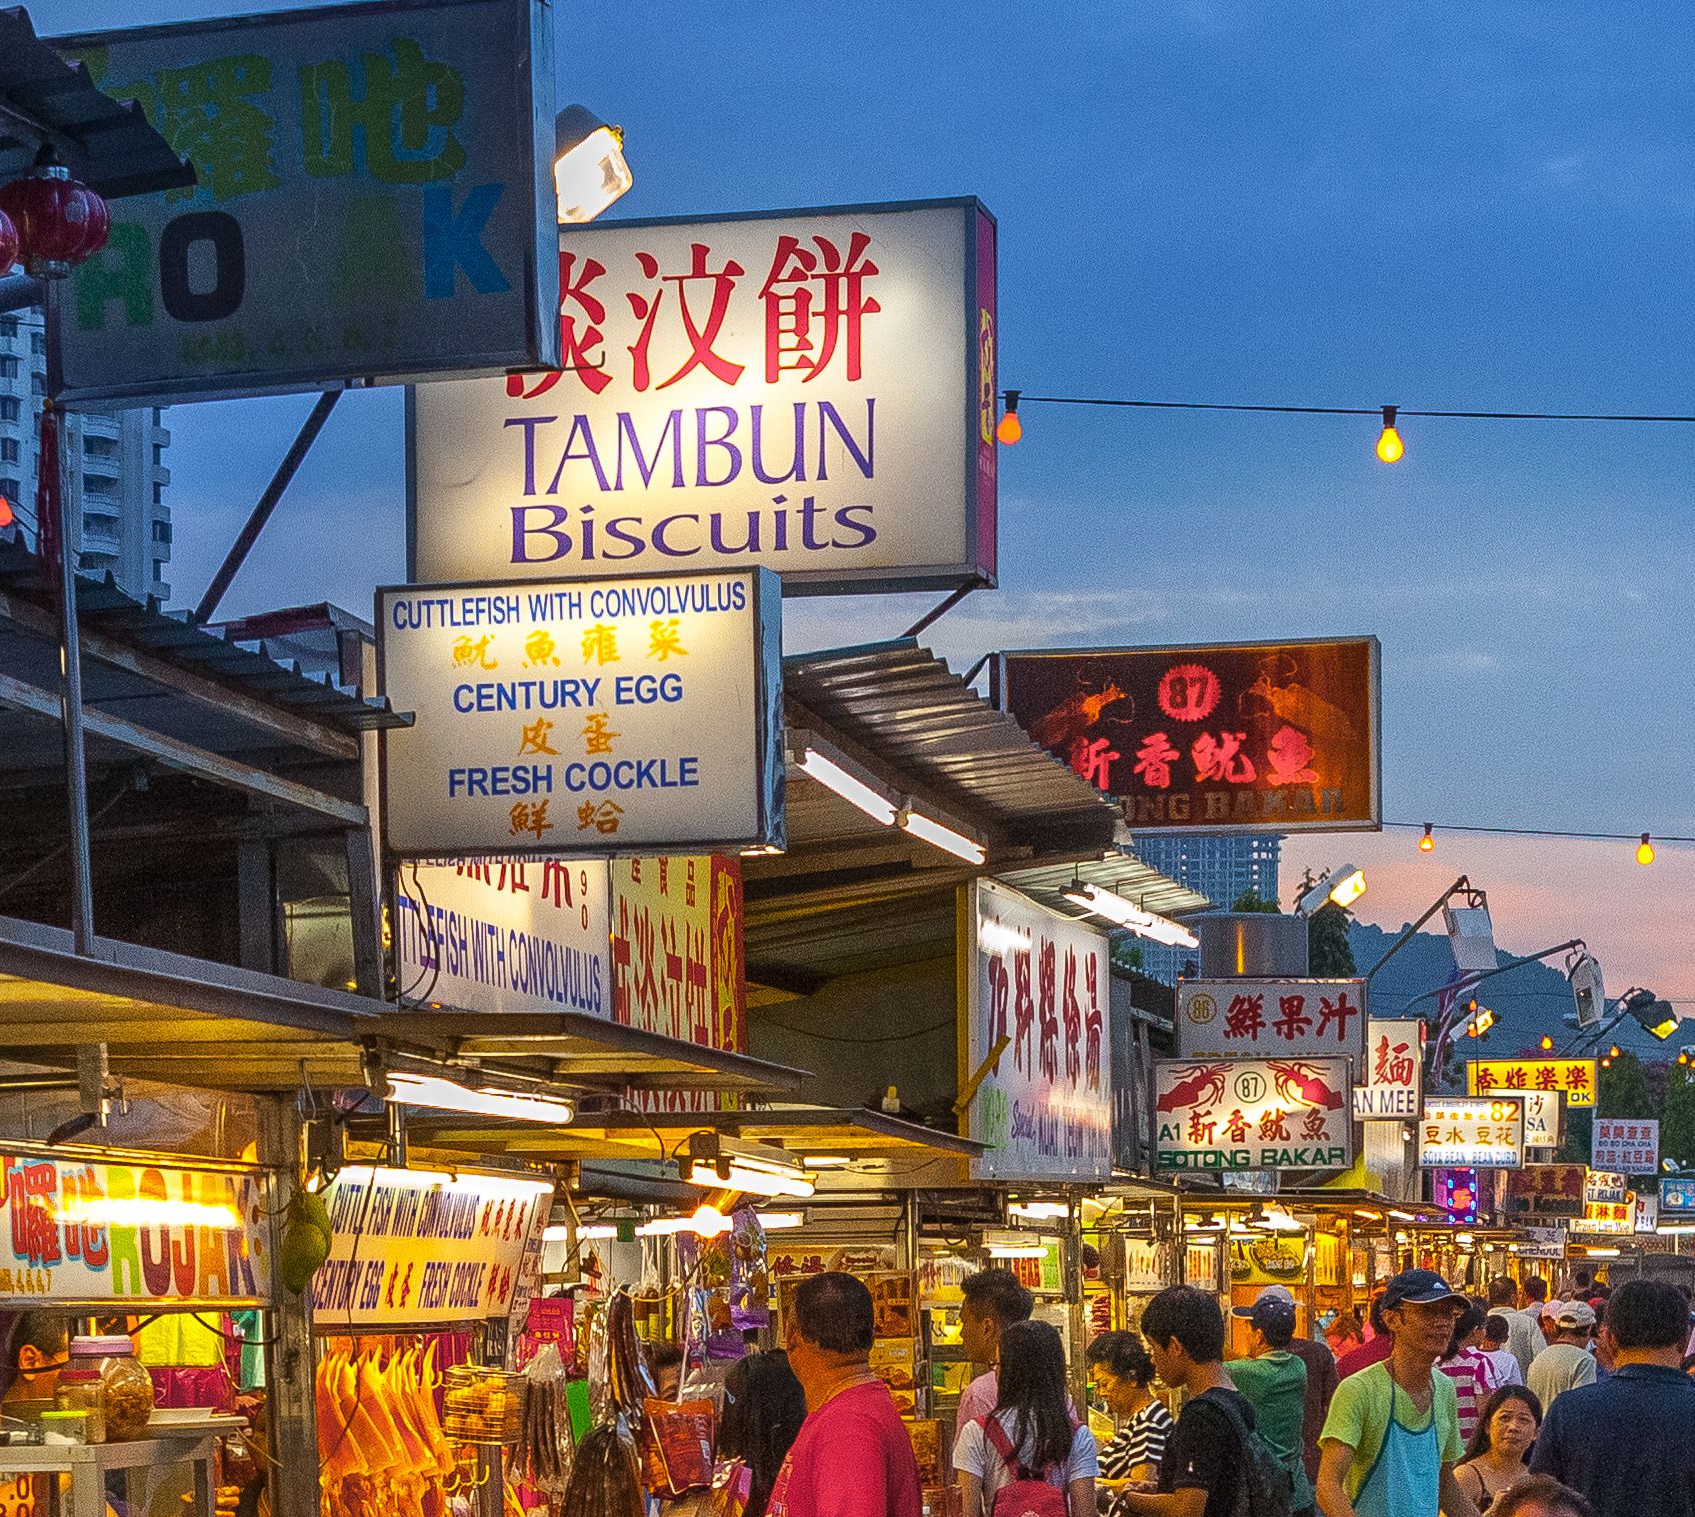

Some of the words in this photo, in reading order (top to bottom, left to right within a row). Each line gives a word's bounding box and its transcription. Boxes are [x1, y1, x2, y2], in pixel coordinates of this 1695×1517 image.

[504, 397, 877, 497] TAMBUN
[509, 494, 879, 566] Biscuits
[392, 594, 520, 631] CUTTLEFISH
[528, 588, 583, 623] WITH
[589, 581, 746, 619] CONVOLVULUS
[453, 677, 602, 714] CENTURY
[614, 673, 684, 705] EGG
[518, 712, 622, 757] 皮蛋
[449, 764, 553, 799] FRESH
[564, 757, 699, 793] COCKLE
[471, 918, 506, 989] WITH
[507, 928, 602, 1014] CONVOLVULUS
[1223, 992, 1358, 1041] 鮮果汁
[1379, 1089, 1416, 1113] MEE
[1491, 1101, 1520, 1123] 82
[1158, 1122, 1181, 1142] A1
[1187, 1107, 1331, 1146] 新香魷魚
[1158, 1150, 1251, 1169] SOTONG
[1261, 1147, 1346, 1167] BAKAR
[107, 1166, 257, 1297] ROJAK
[358, 1259, 385, 1310] EGG
[417, 1261, 453, 1309] FRESH
[448, 1261, 487, 1308] COCKLE
